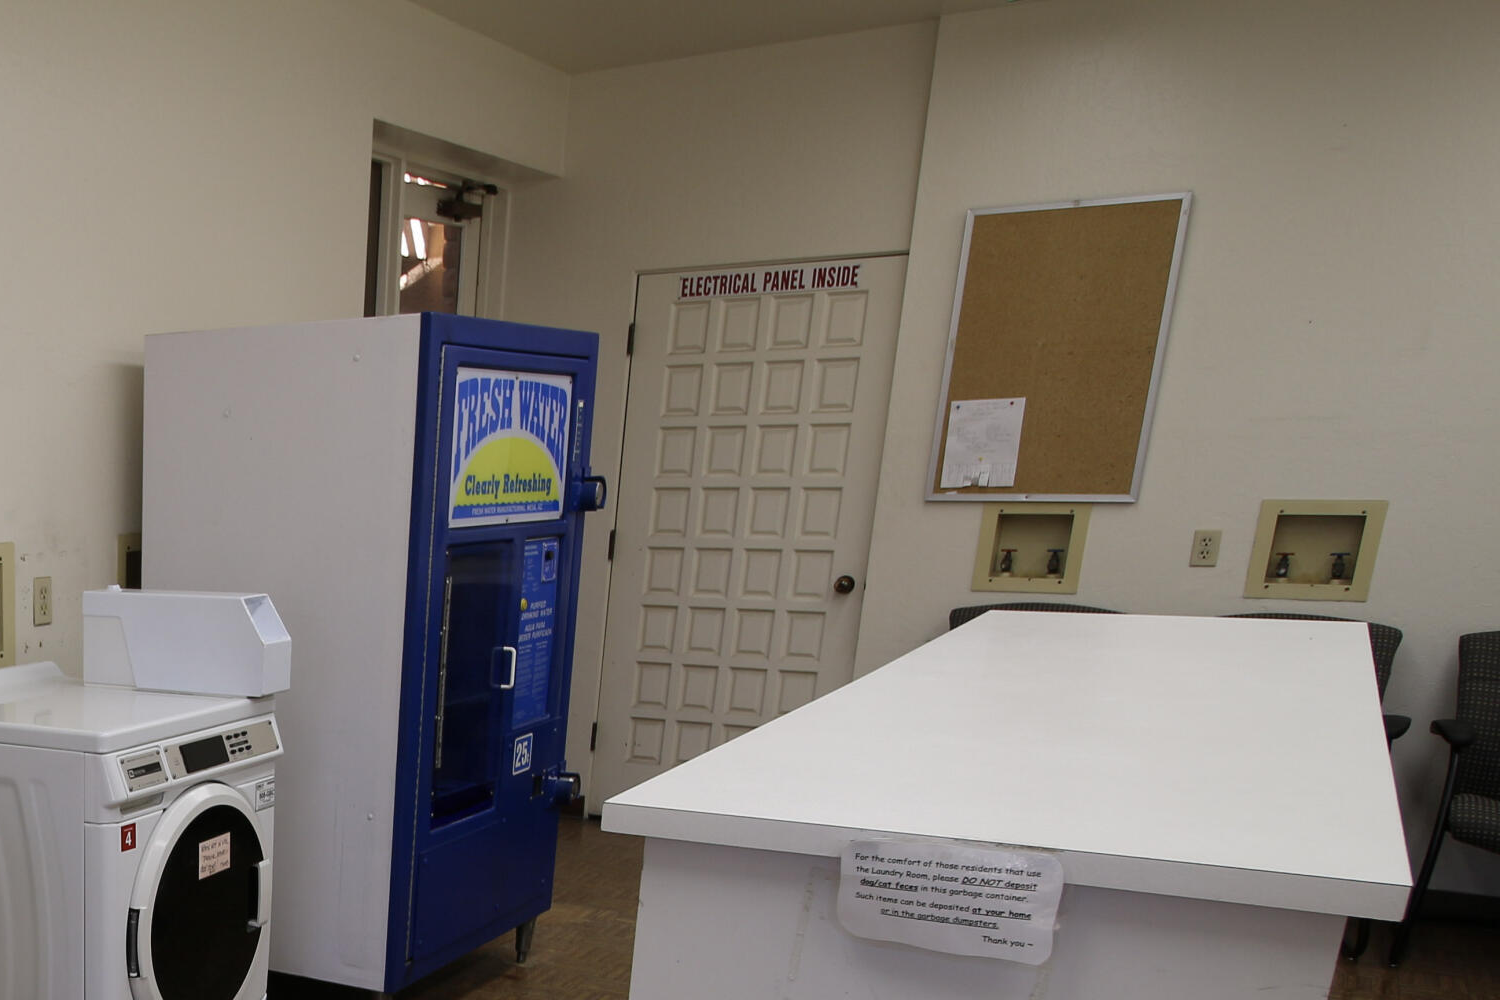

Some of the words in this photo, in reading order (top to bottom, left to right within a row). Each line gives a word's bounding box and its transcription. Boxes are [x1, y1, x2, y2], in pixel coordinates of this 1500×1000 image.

[681, 272, 757, 298] ELECTRICAL
[763, 269, 806, 292] PANEL
[811, 265, 861, 289] INSIDE
[453, 377, 515, 484] FRESH
[518, 379, 568, 484] WATER
[464, 473, 500, 500] Clearly
[502, 472, 552, 497] Refreshing
[125, 831, 132, 846] 4
[855, 852, 869, 861] For
[871, 855, 885, 863] the
[887, 857, 921, 867] comfort
[935, 861, 959, 871] those
[960, 864, 1003, 874] residents
[1005, 868, 1024, 876] that
[860, 878, 892, 890] dog/cat
[895, 882, 918, 892] feces
[931, 886, 947, 894] this
[949, 888, 983, 899] garbage
[985, 892, 1029, 903] container.
[871, 867, 904, 879] Laundry
[906, 870, 930, 881] Room,
[932, 873, 959, 883] please
[961, 876, 978, 885] DO
[979, 878, 1003, 888] NOT
[1004, 880, 1038, 892] deposit
[855, 892, 873, 901] Such
[875, 895, 898, 904] items
[916, 899, 926, 908] be
[928, 901, 971, 913] deposited
[972, 907, 982, 915] at
[985, 909, 1006, 918] your
[1008, 909, 1032, 920] home
[892, 909, 899, 917] in
[901, 910, 914, 919] the
[917, 912, 950, 923] garbage
[982, 935, 1008, 945] Thank
[1010, 940, 1026, 948] you
